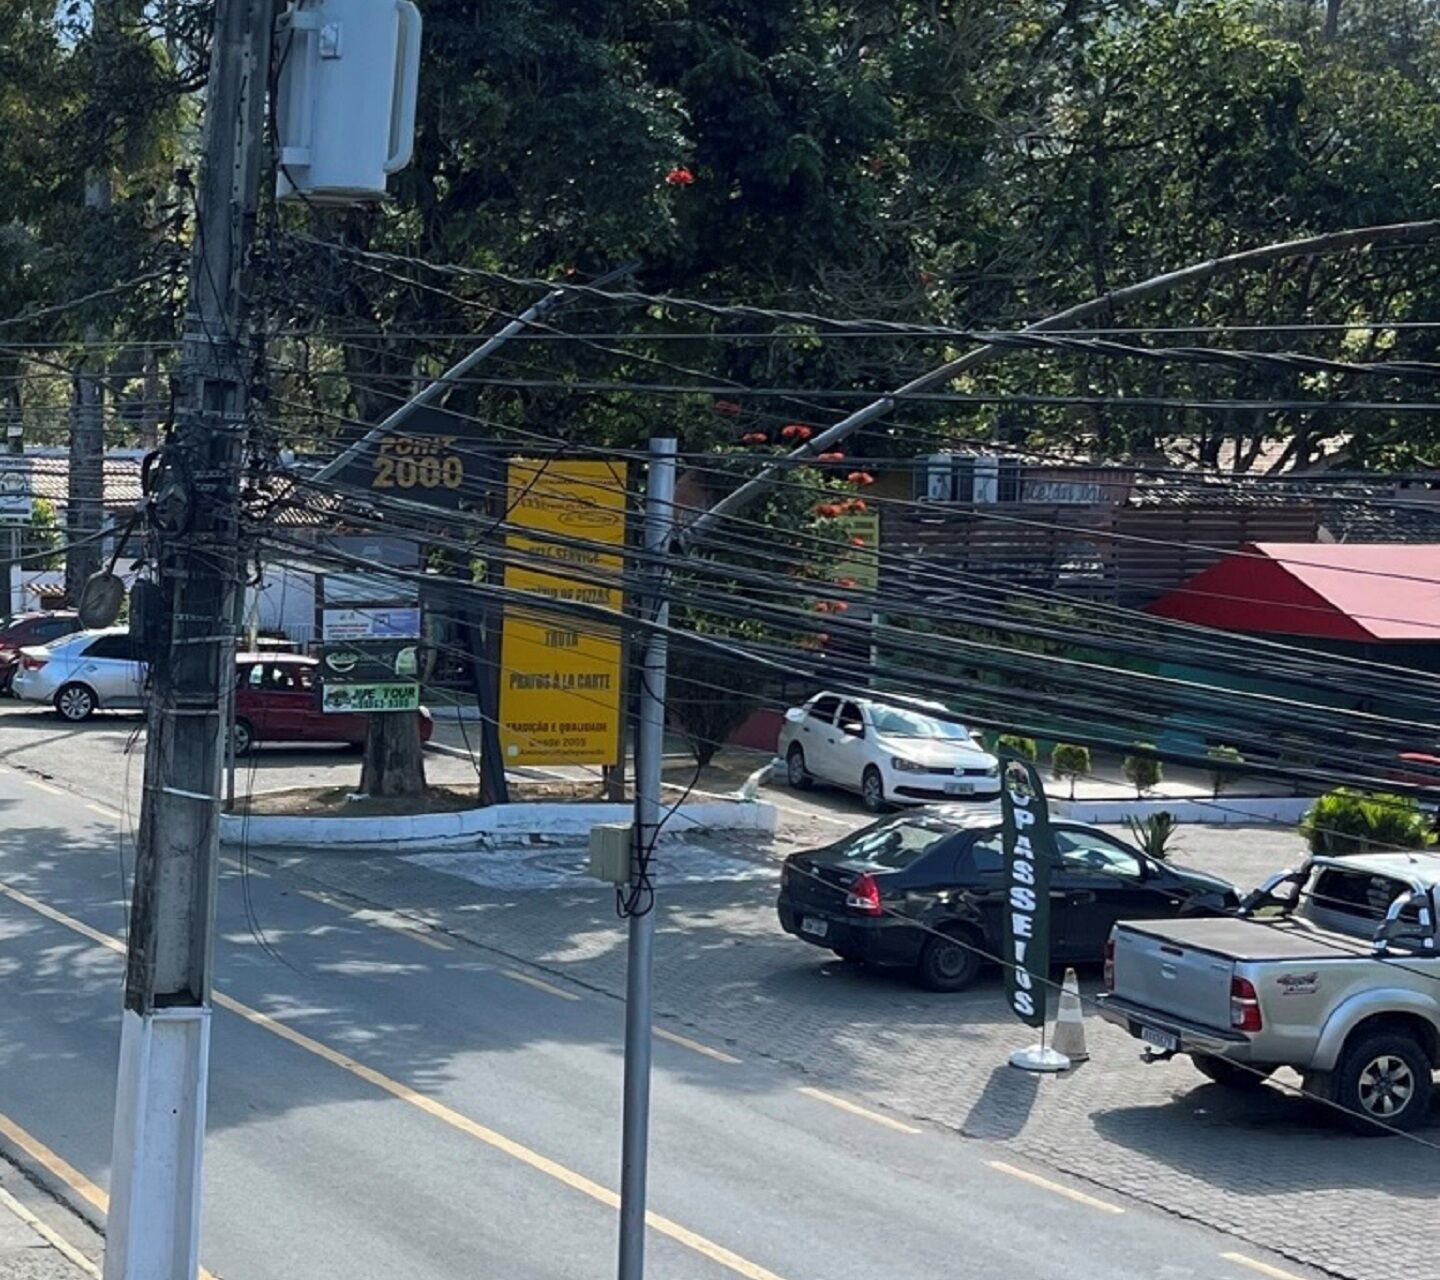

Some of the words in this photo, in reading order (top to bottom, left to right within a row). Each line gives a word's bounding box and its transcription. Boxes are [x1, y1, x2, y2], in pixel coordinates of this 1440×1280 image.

[372, 456, 464, 489] 2000
[383, 687, 416, 699] TOUR
[506, 721, 549, 734] TRADIÇÃO
[551, 722, 558, 732] E
[559, 722, 608, 735] QUALIDADE
